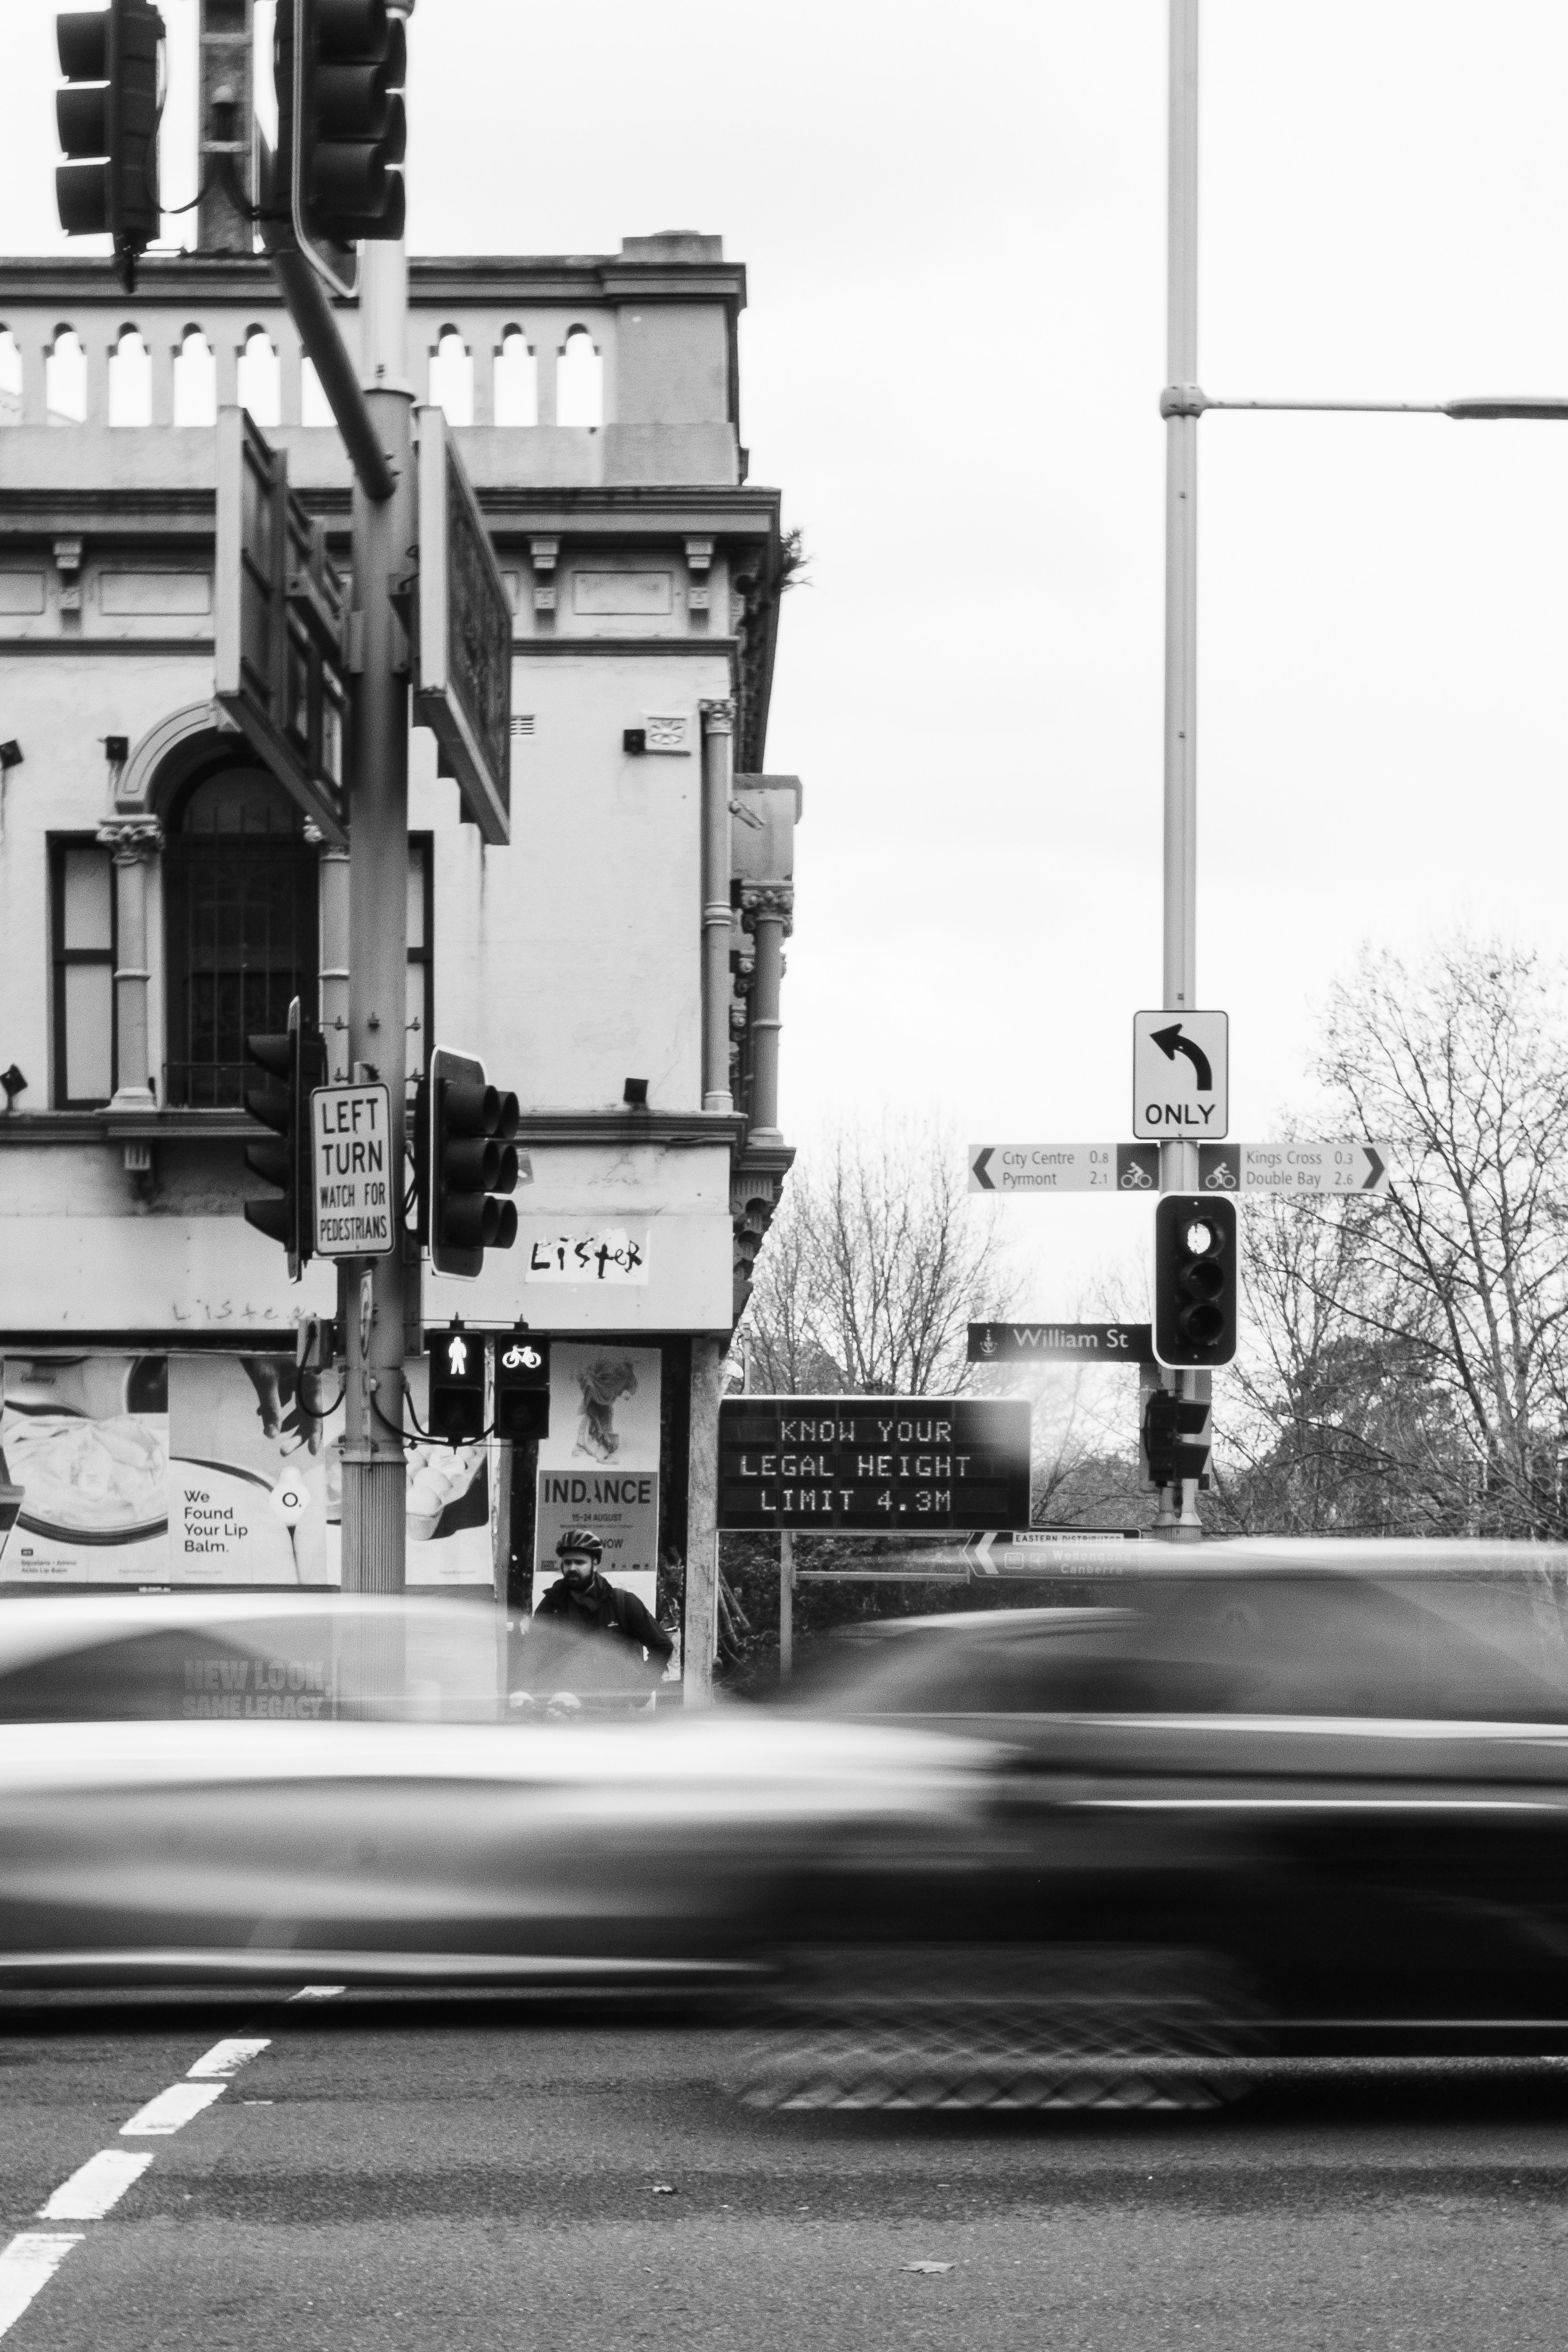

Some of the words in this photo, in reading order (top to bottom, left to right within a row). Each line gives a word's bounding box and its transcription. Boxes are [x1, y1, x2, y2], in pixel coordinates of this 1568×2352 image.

[322, 1097, 378, 1134] LEFT
[1145, 1103, 1216, 1124] ONLY
[322, 1139, 382, 1176] TURN
[1002, 1151, 1027, 1169] City
[1032, 1151, 1075, 1165] Centre
[1089, 1150, 1109, 1164] 0.8
[1246, 1150, 1282, 1168] Kings
[1287, 1150, 1322, 1165] Cross
[1334, 1150, 1353, 1165] 0.3
[1002, 1171, 1057, 1189] Pyrmont
[1090, 1171, 1108, 1185] 2.1
[1246, 1171, 1293, 1185] Double
[1298, 1171, 1321, 1189] Bay
[1334, 1171, 1353, 1185] 2.6
[320, 1185, 355, 1208] WATCH
[364, 1182, 385, 1206] FOR
[319, 1215, 387, 1242] PEDESTRIANS
[1013, 1324, 1098, 1347] William
[1106, 1323, 1129, 1347] St
[781, 1420, 855, 1442] KNOW
[877, 1420, 952, 1442] YOUR
[740, 1455, 834, 1476] LEGAL
[858, 1455, 970, 1476] HEIGHT
[184, 1490, 210, 1503] We
[761, 1490, 854, 1511] LIMIT
[877, 1490, 951, 1511] 4.3M
[184, 1507, 233, 1519] Found
[184, 1523, 220, 1536] Your
[224, 1523, 248, 1539] Lip
[1015, 1534, 1058, 1543] EASTERN
[184, 1540, 229, 1553] Balm.
